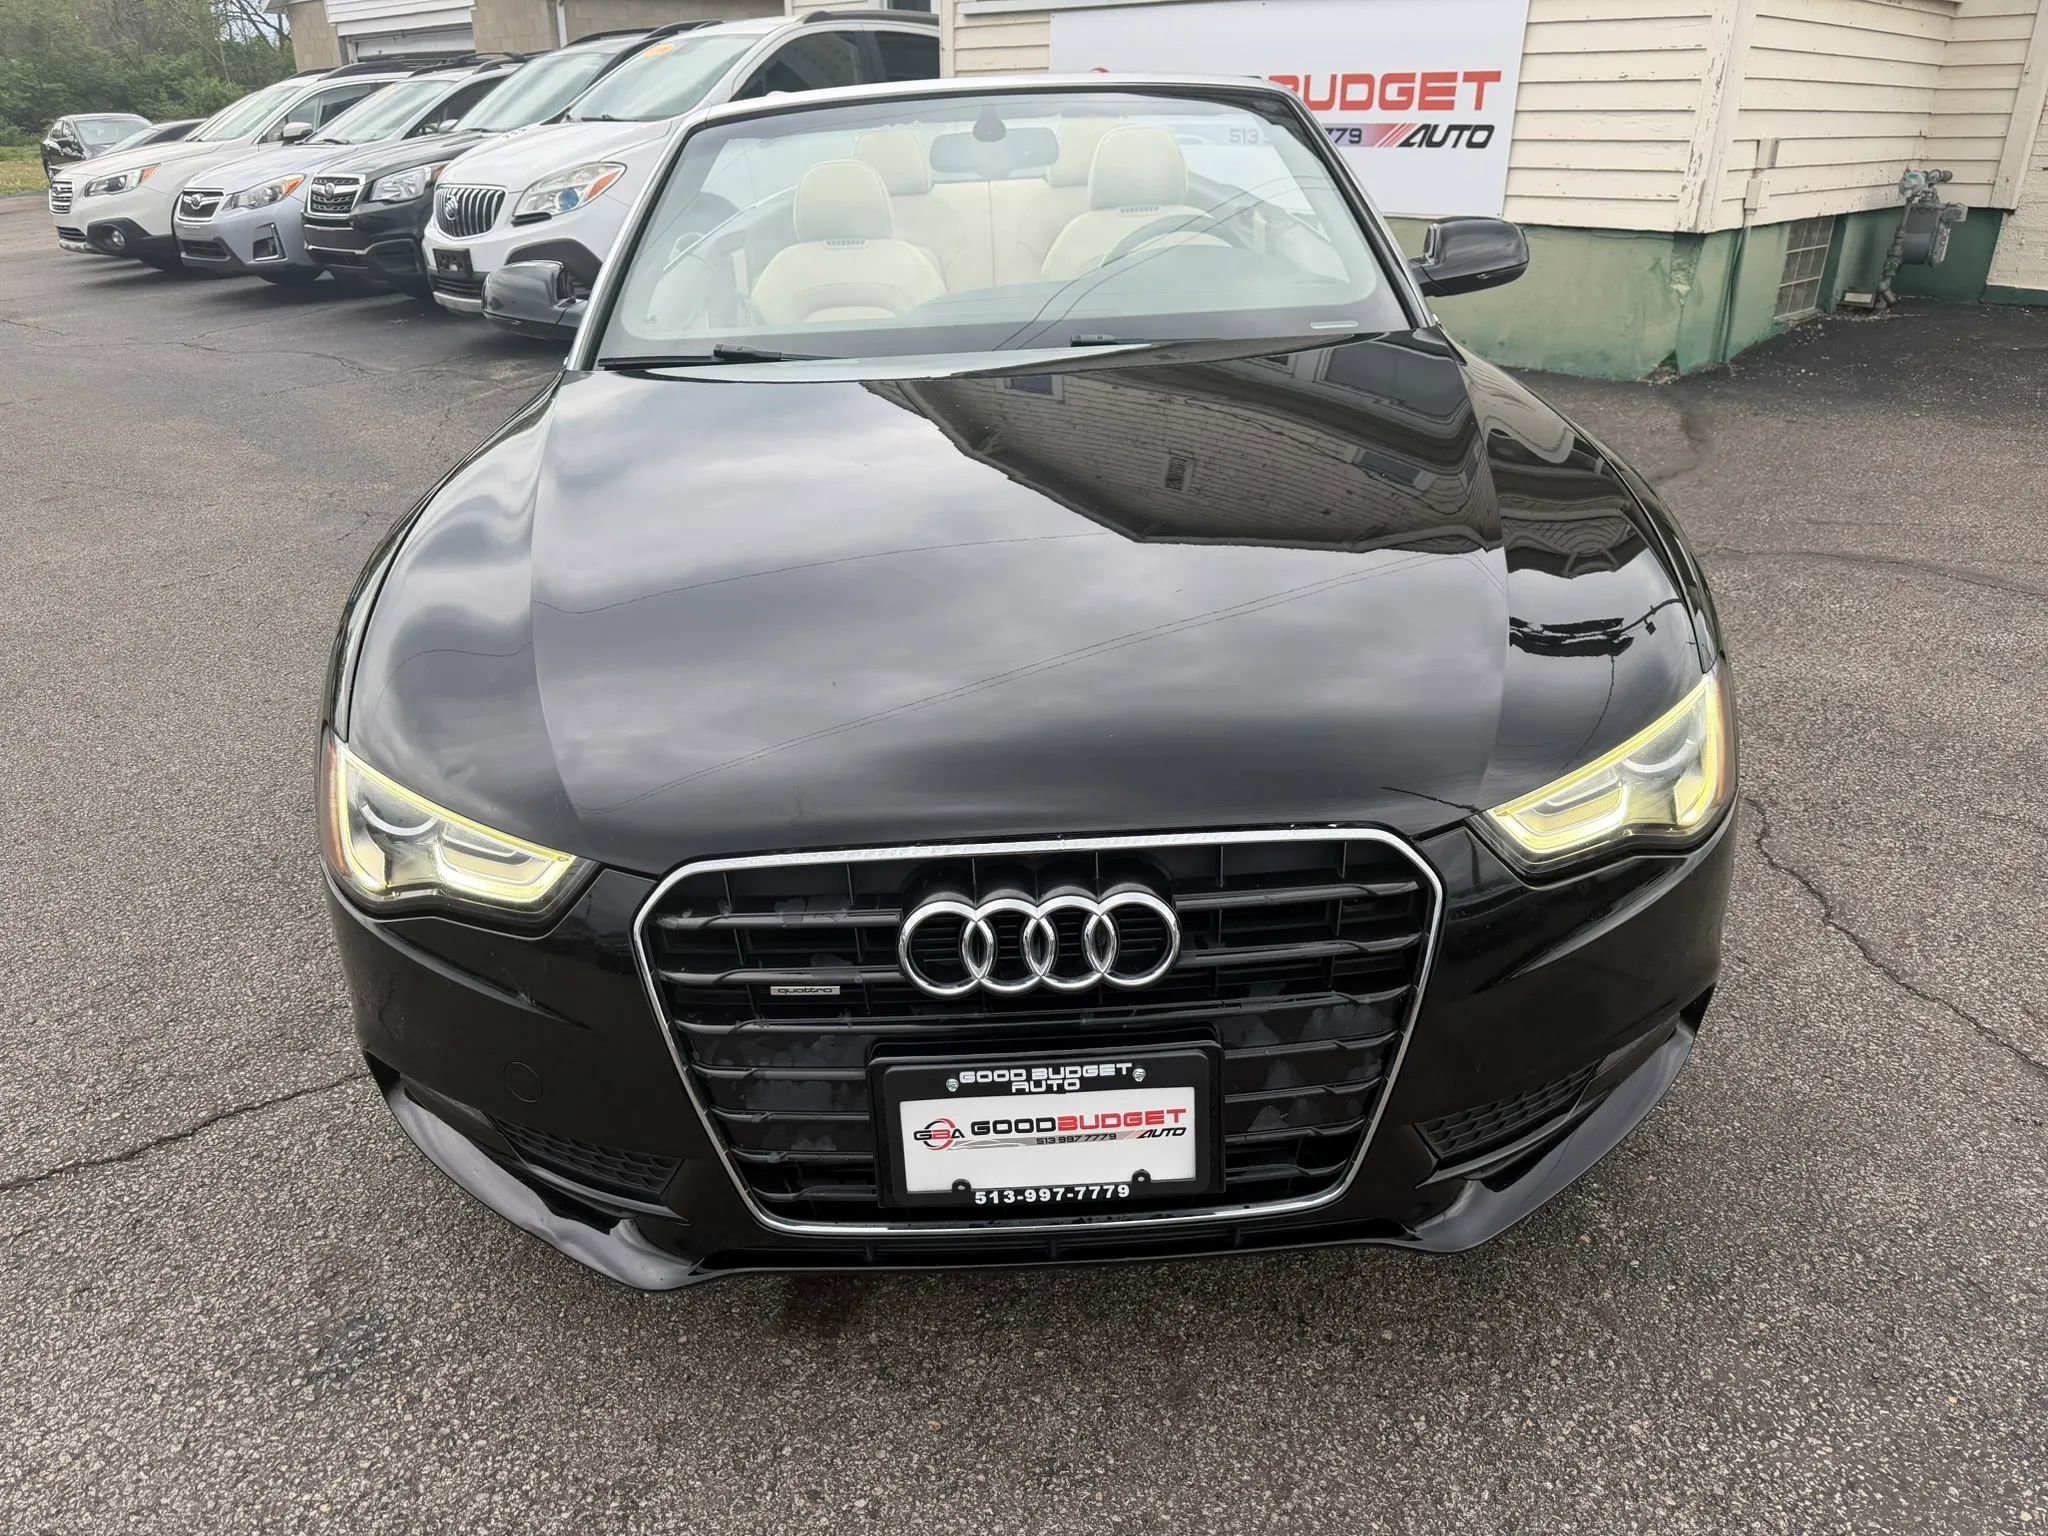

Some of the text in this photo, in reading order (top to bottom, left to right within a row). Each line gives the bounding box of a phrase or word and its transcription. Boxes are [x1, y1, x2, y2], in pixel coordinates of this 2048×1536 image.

[1229, 128, 1259, 144] 513
[1397, 124, 1495, 148] AUTO
[959, 1063, 1132, 1083] GOOD BUDGET
[1012, 1078, 1080, 1093] AUTO
[913, 1128, 966, 1141] GBA
[1036, 1133, 1117, 1145] 513 997 7779
[1137, 1127, 1187, 1139] AUTO
[975, 1184, 1130, 1205] 513-997-7779
